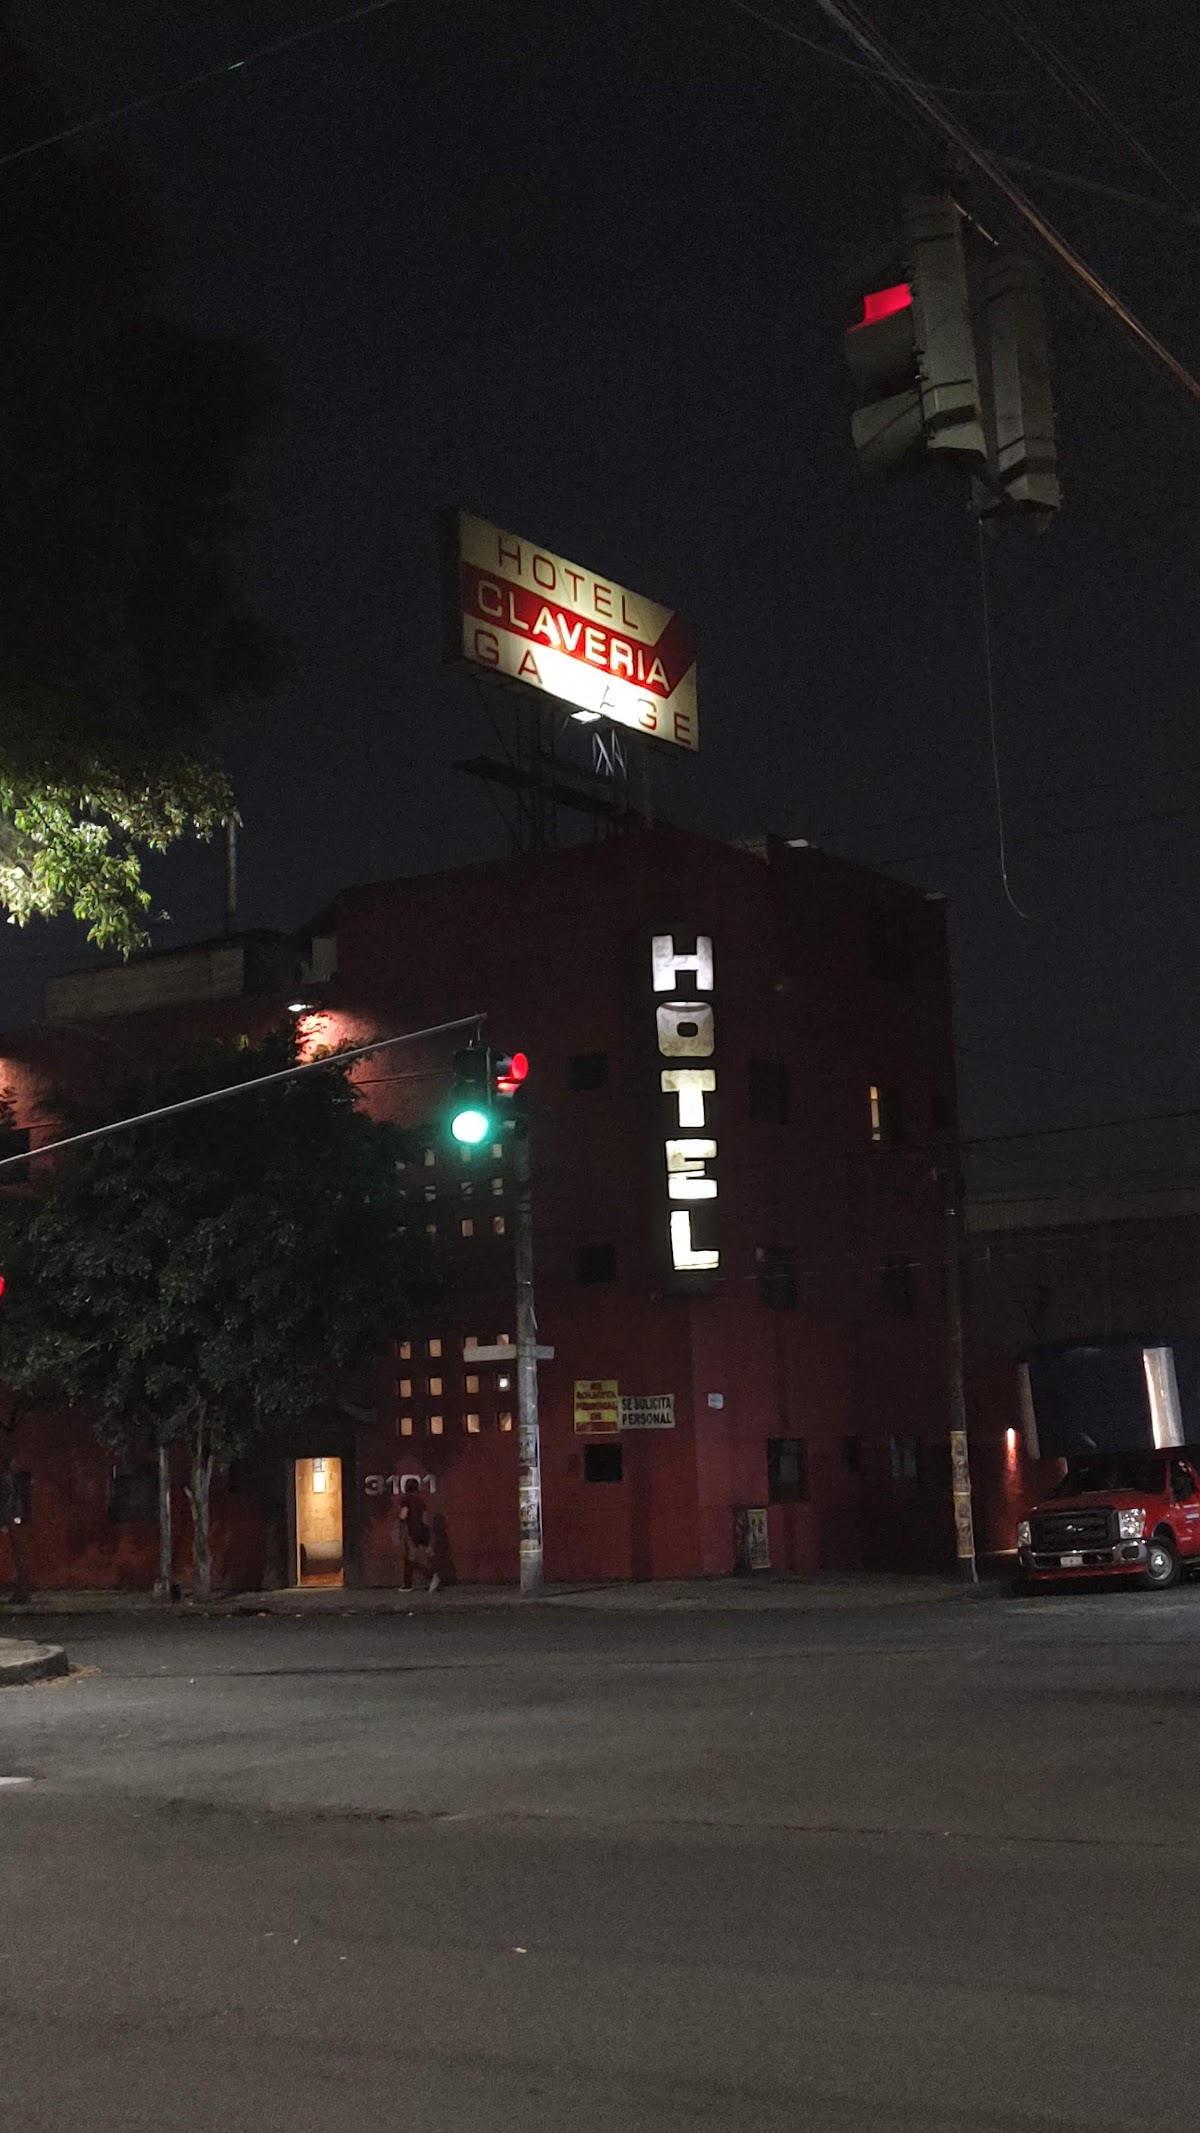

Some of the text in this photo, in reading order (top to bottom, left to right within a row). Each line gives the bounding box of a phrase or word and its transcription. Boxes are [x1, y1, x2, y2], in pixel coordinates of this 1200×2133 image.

[498, 536, 638, 630] HOTEL
[477, 580, 671, 692] CLAVERIA
[475, 630, 691, 745] GAGE
[652, 935, 719, 1270] HOTEL
[622, 1399, 633, 1411] SE
[634, 1397, 671, 1411] SOLICITA
[622, 1414, 672, 1425] PERSONAL
[365, 1474, 436, 1497] 3101
